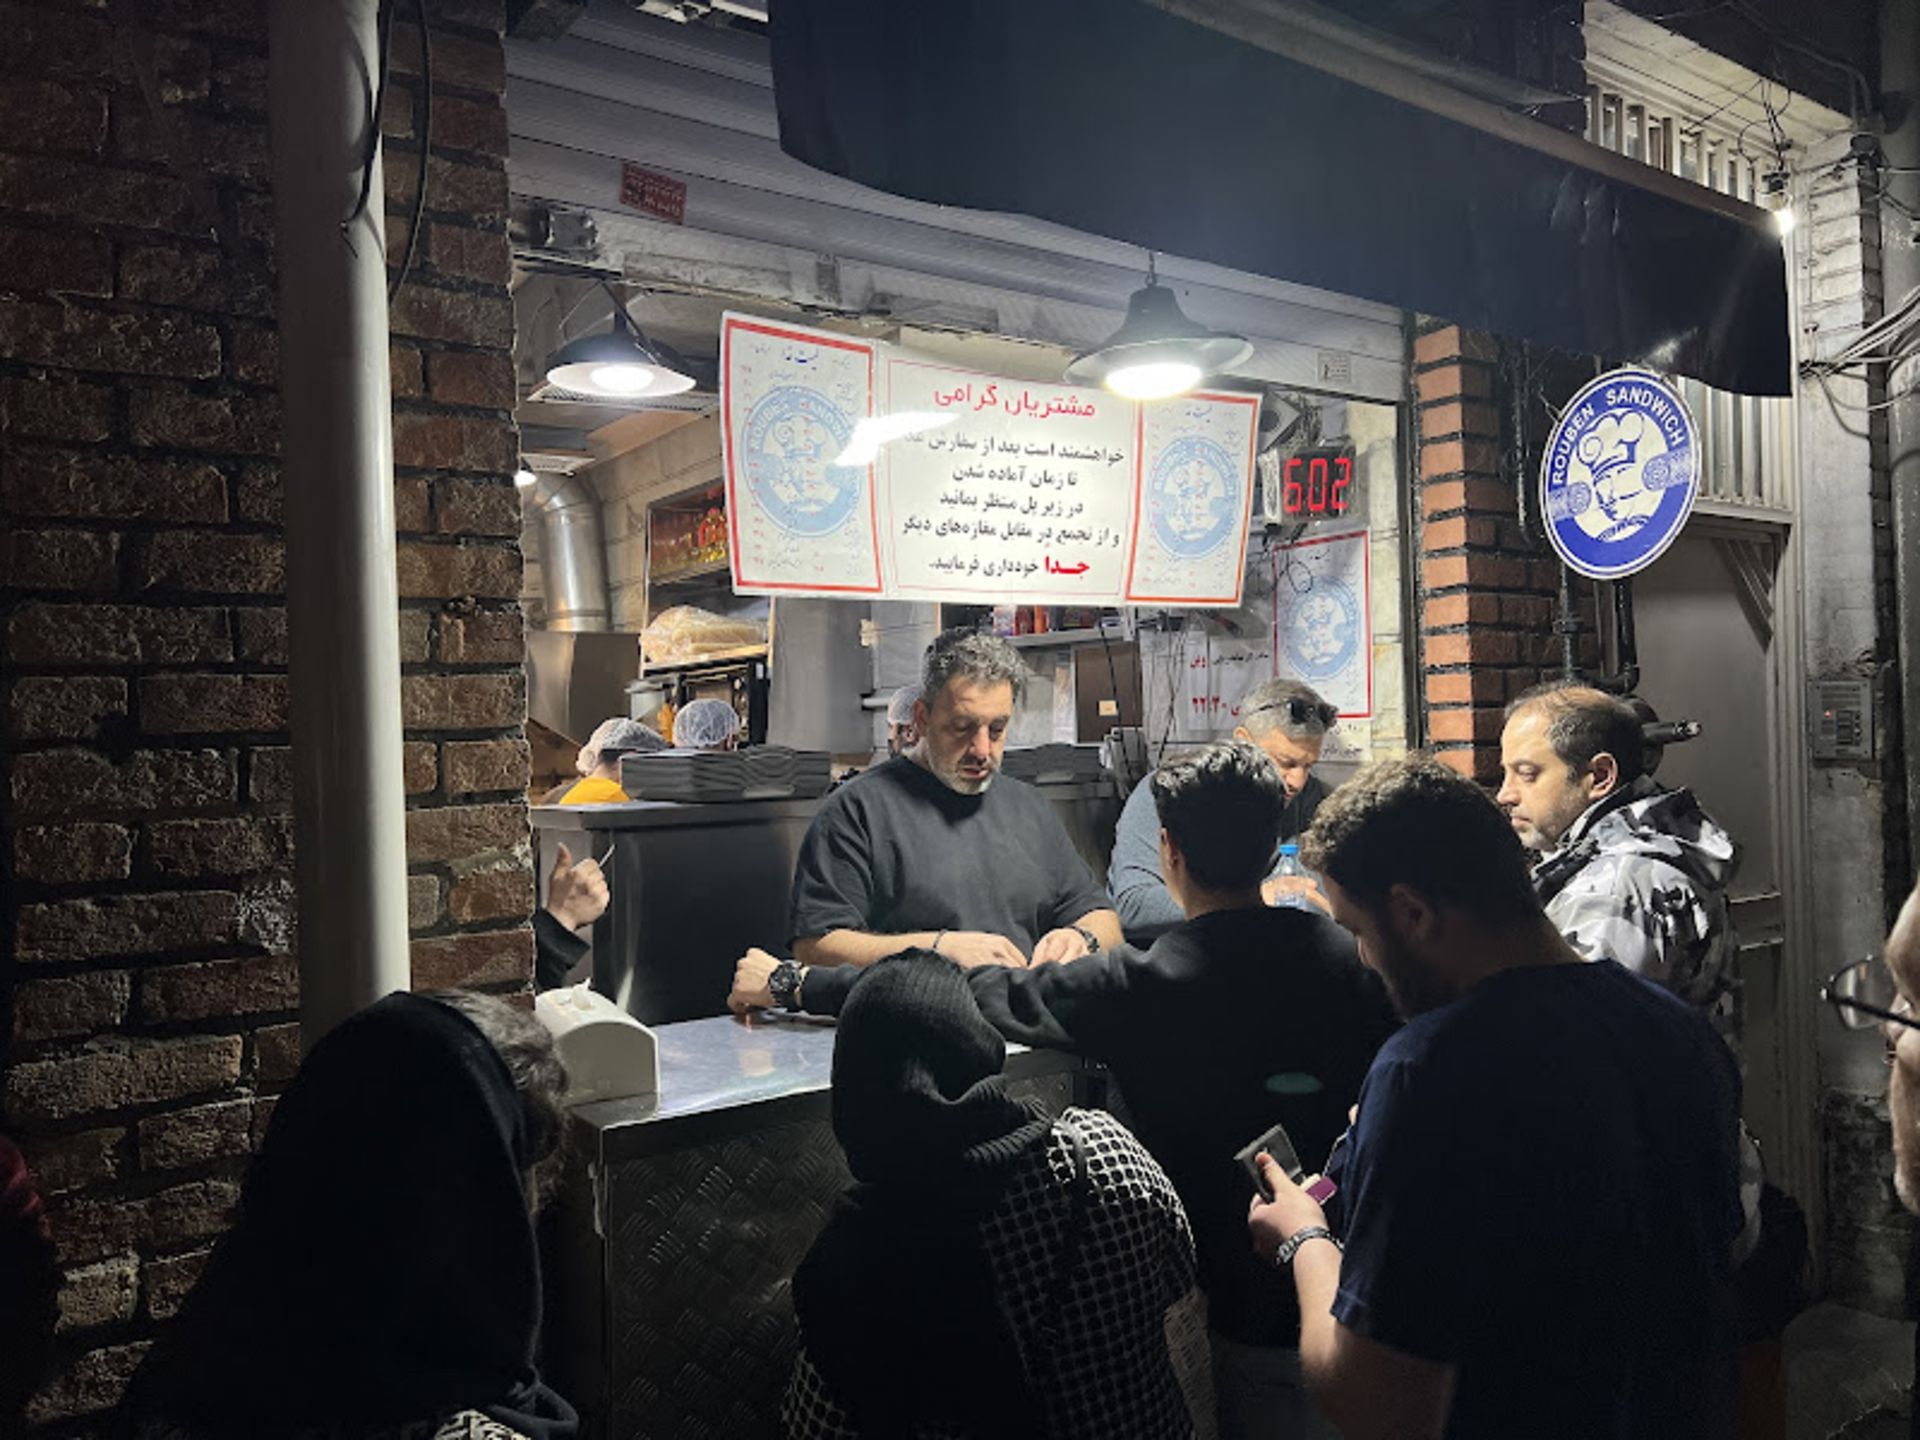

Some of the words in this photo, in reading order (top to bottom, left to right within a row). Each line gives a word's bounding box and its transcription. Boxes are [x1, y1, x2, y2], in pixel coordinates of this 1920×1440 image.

[934, 383, 998, 412] گرامی
[1004, 390, 1096, 419] مشتریان
[928, 431, 978, 453] سفارش
[1552, 402, 1596, 485] ROUBEN
[1605, 386, 1686, 448] SANDWICH
[981, 436, 995, 457] از
[997, 440, 1021, 459] بعد
[1023, 442, 1056, 457] است
[1057, 445, 1125, 468] خواهشمند
[952, 463, 985, 482] شدن
[987, 464, 1028, 482] آماده
[1029, 468, 1064, 492] زمان
[1066, 471, 1078, 487] تا
[1282, 457, 1352, 514] 602
[939, 488, 978, 509] بمانید
[981, 492, 1018, 513] منتظر
[1019, 495, 1038, 516] پل
[1040, 500, 1064, 518] زیر
[1066, 502, 1084, 519] در
[902, 515, 932, 536] دیگر
[999, 521, 1033, 542] مقابل
[1036, 527, 1053, 544] در
[1055, 529, 1093, 547] تجمع
[1096, 527, 1110, 547] از
[1111, 534, 1121, 548] و
[982, 557, 1040, 579] خودداری
